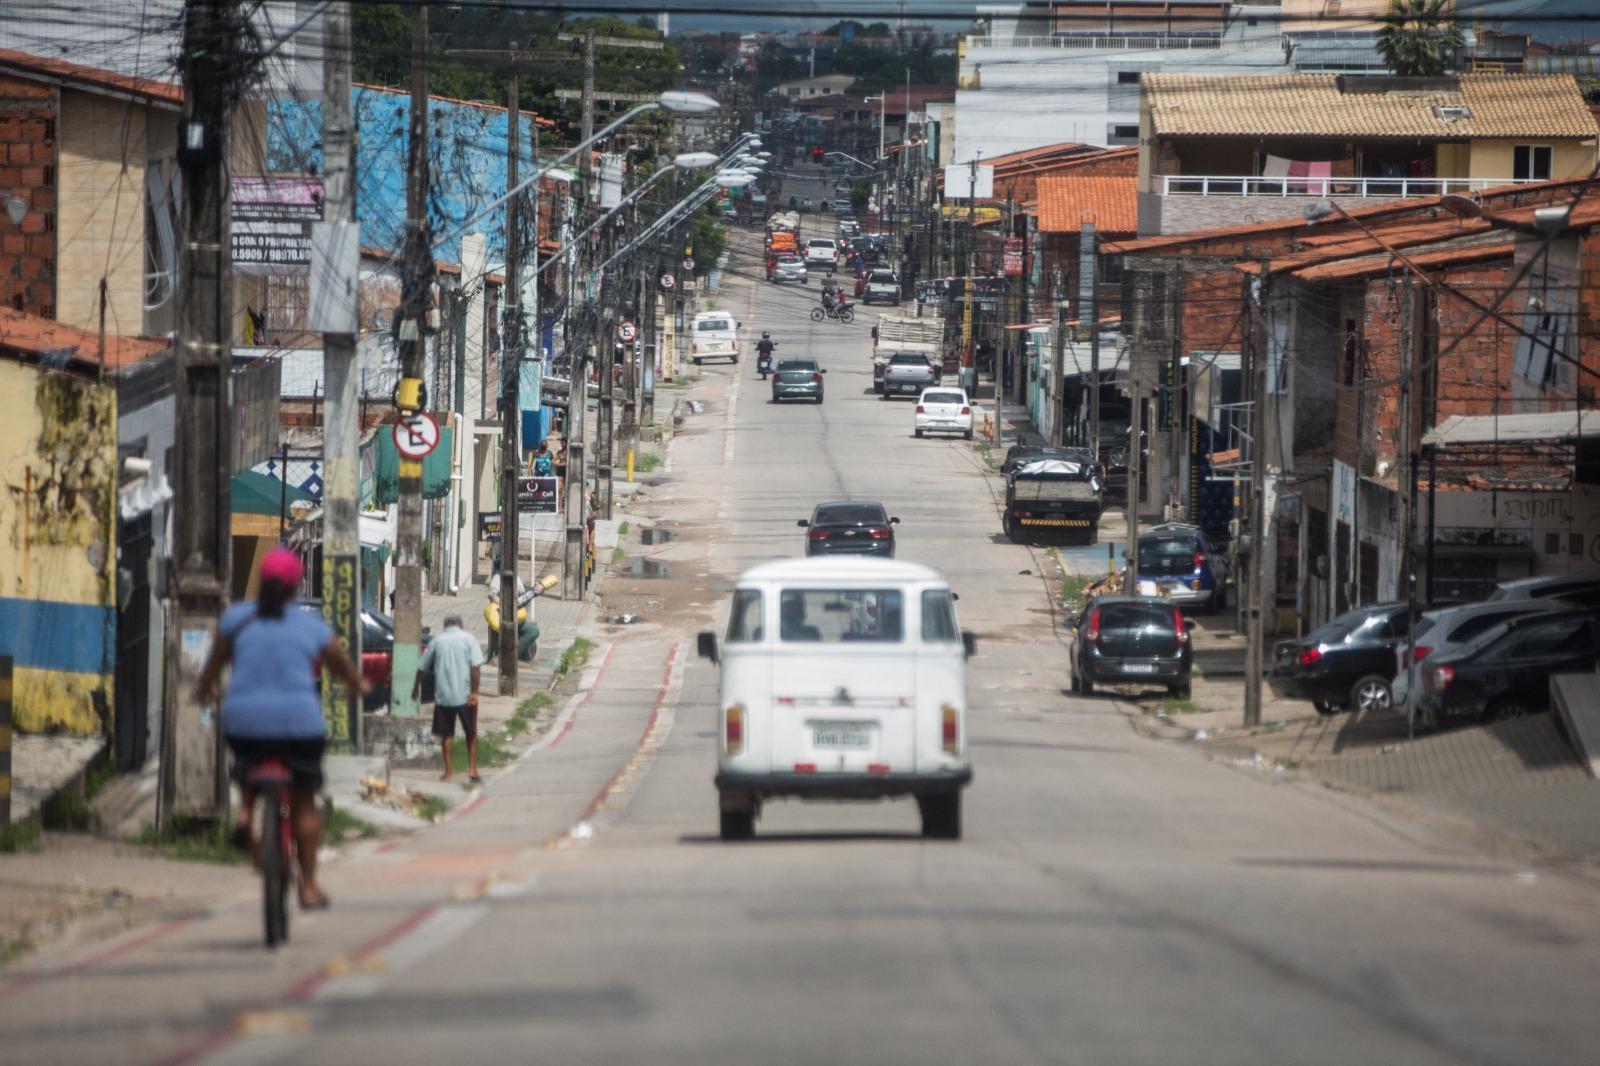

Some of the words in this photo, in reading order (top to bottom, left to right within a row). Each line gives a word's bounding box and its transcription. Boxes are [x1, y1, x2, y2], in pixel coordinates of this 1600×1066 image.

[239, 236, 257, 246] COM
[258, 236, 264, 246] O
[623, 325, 632, 336] E
[407, 420, 425, 447] E
